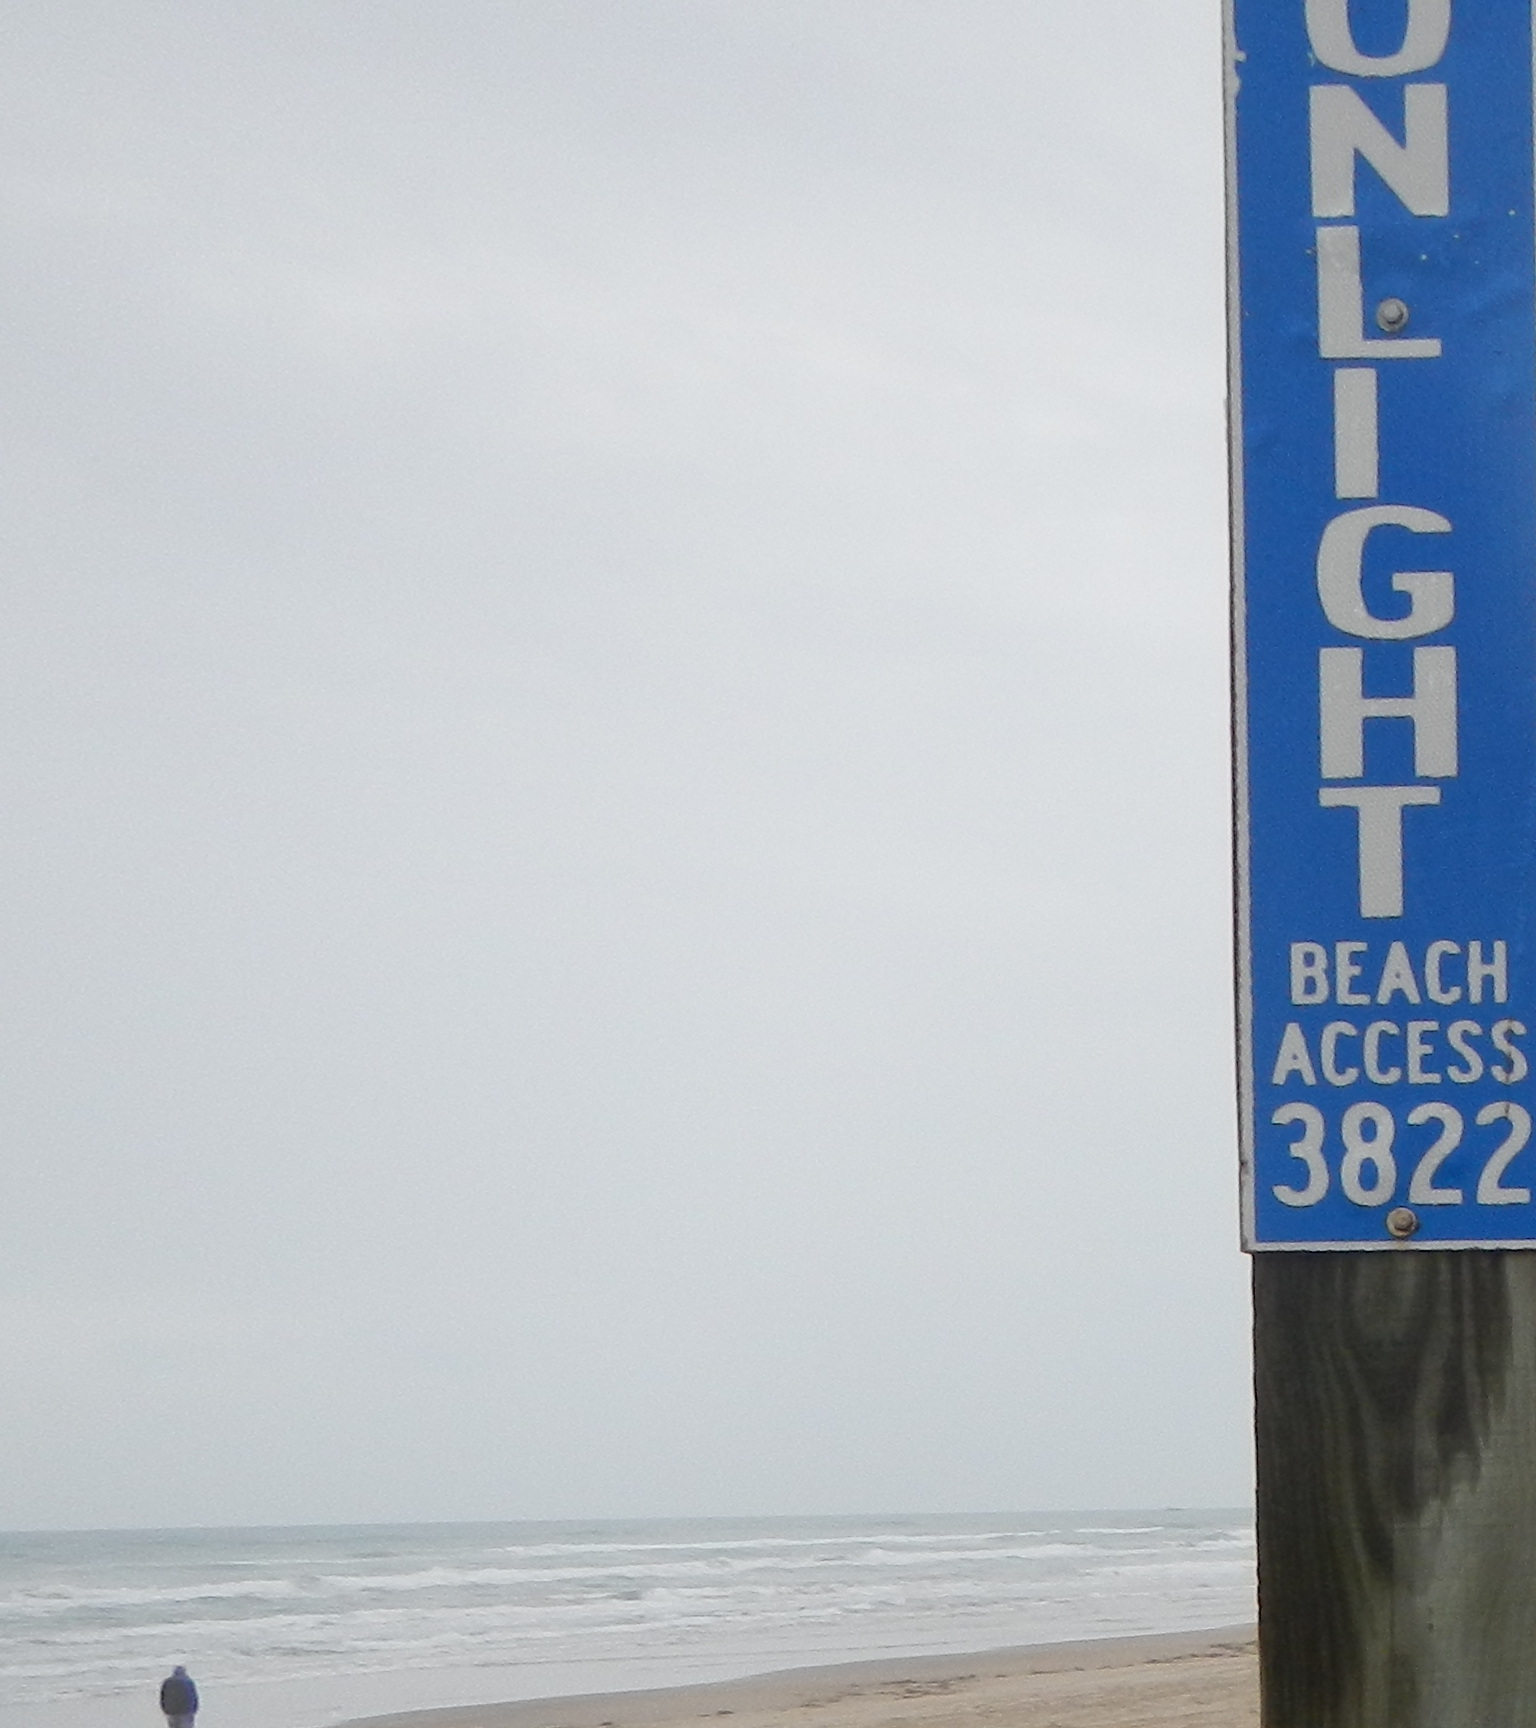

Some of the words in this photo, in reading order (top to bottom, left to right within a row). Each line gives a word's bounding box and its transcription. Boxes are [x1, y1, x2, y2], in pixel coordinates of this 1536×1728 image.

[1289, 939, 1509, 1006] BEACH
[1271, 1018, 1529, 1087] ACCESS
[1271, 1101, 1532, 1208] 3822
